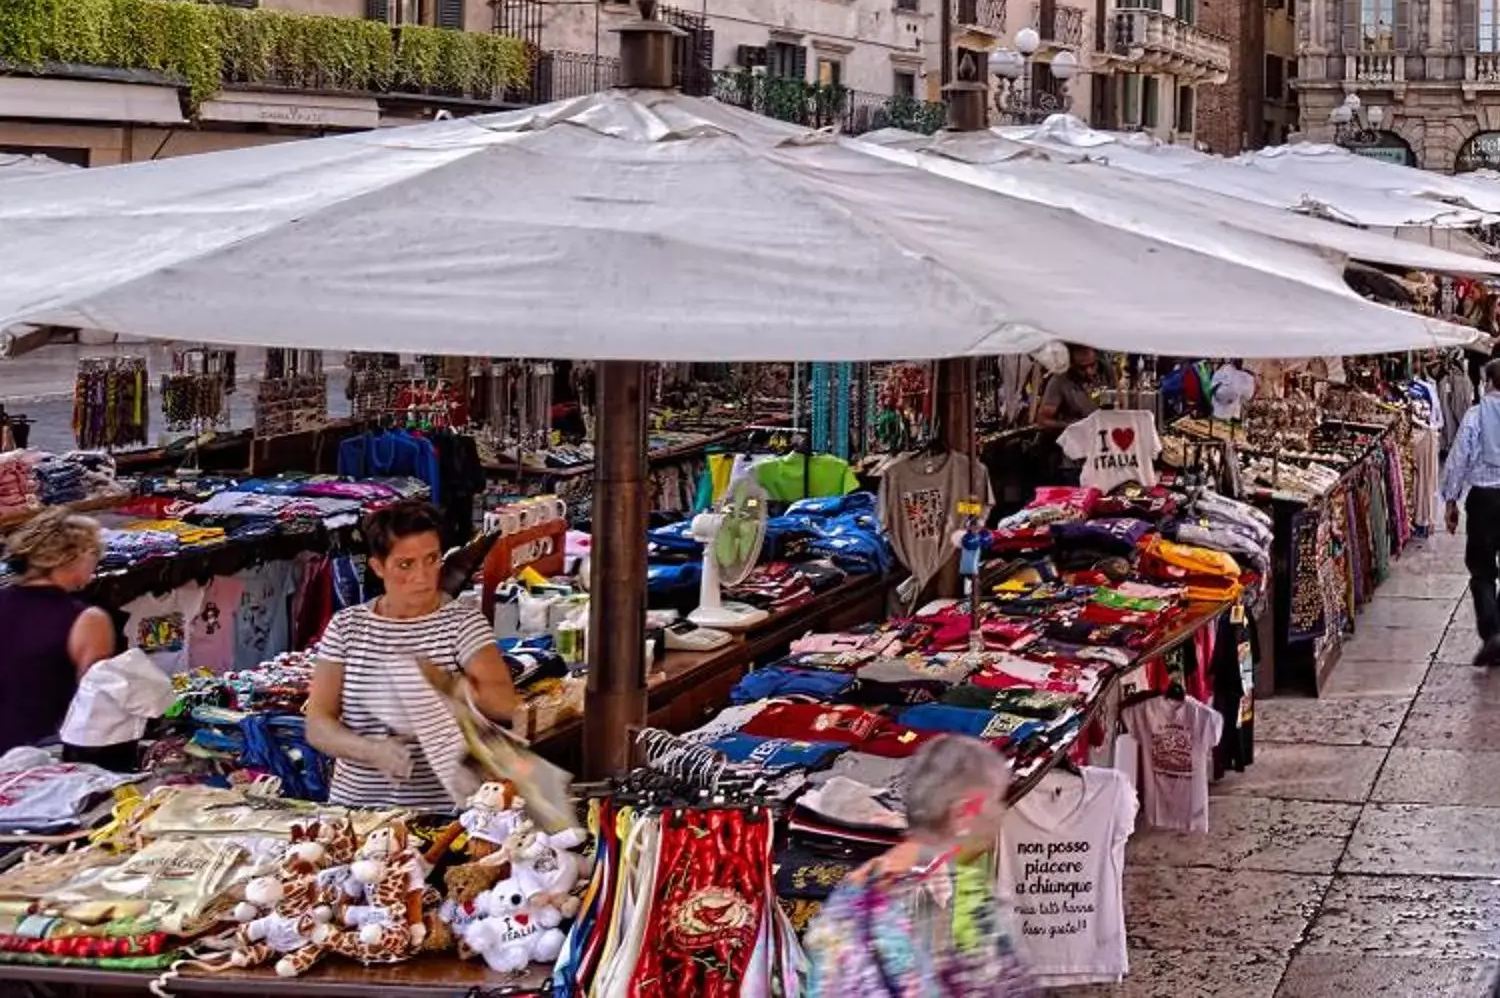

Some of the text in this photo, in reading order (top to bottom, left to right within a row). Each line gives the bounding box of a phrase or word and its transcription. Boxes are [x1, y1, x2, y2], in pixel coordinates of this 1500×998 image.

[1098, 429, 1108, 452] I
[1094, 453, 1139, 470] ITALIA
[1017, 841, 1090, 859] non posso
[1025, 859, 1083, 881] piacere
[1015, 876, 1093, 898] a chiunque
